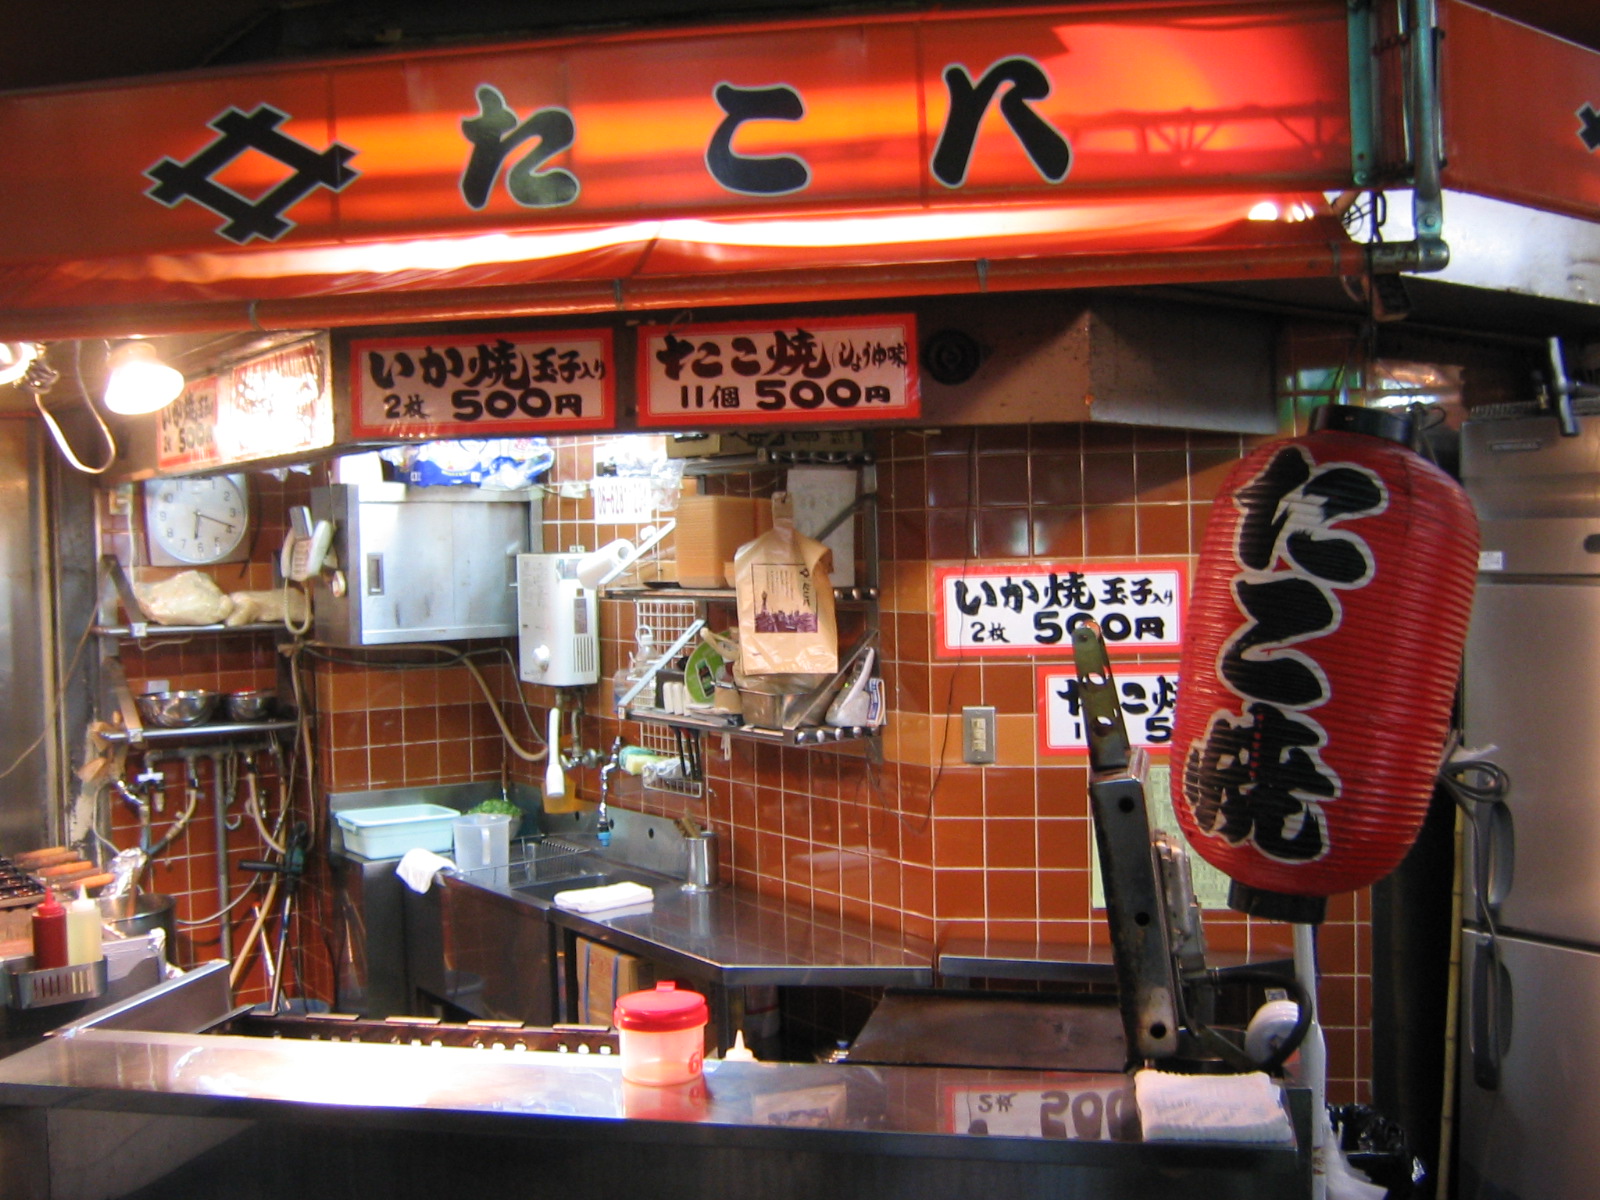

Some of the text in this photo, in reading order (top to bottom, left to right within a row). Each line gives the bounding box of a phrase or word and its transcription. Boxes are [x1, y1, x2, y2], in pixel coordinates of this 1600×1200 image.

[384, 387, 582, 421] 2枚 500円
[681, 378, 890, 410] 11個 500円
[954, 571, 1173, 616] いか焼玉子入り
[971, 621, 1010, 643] 2枚
